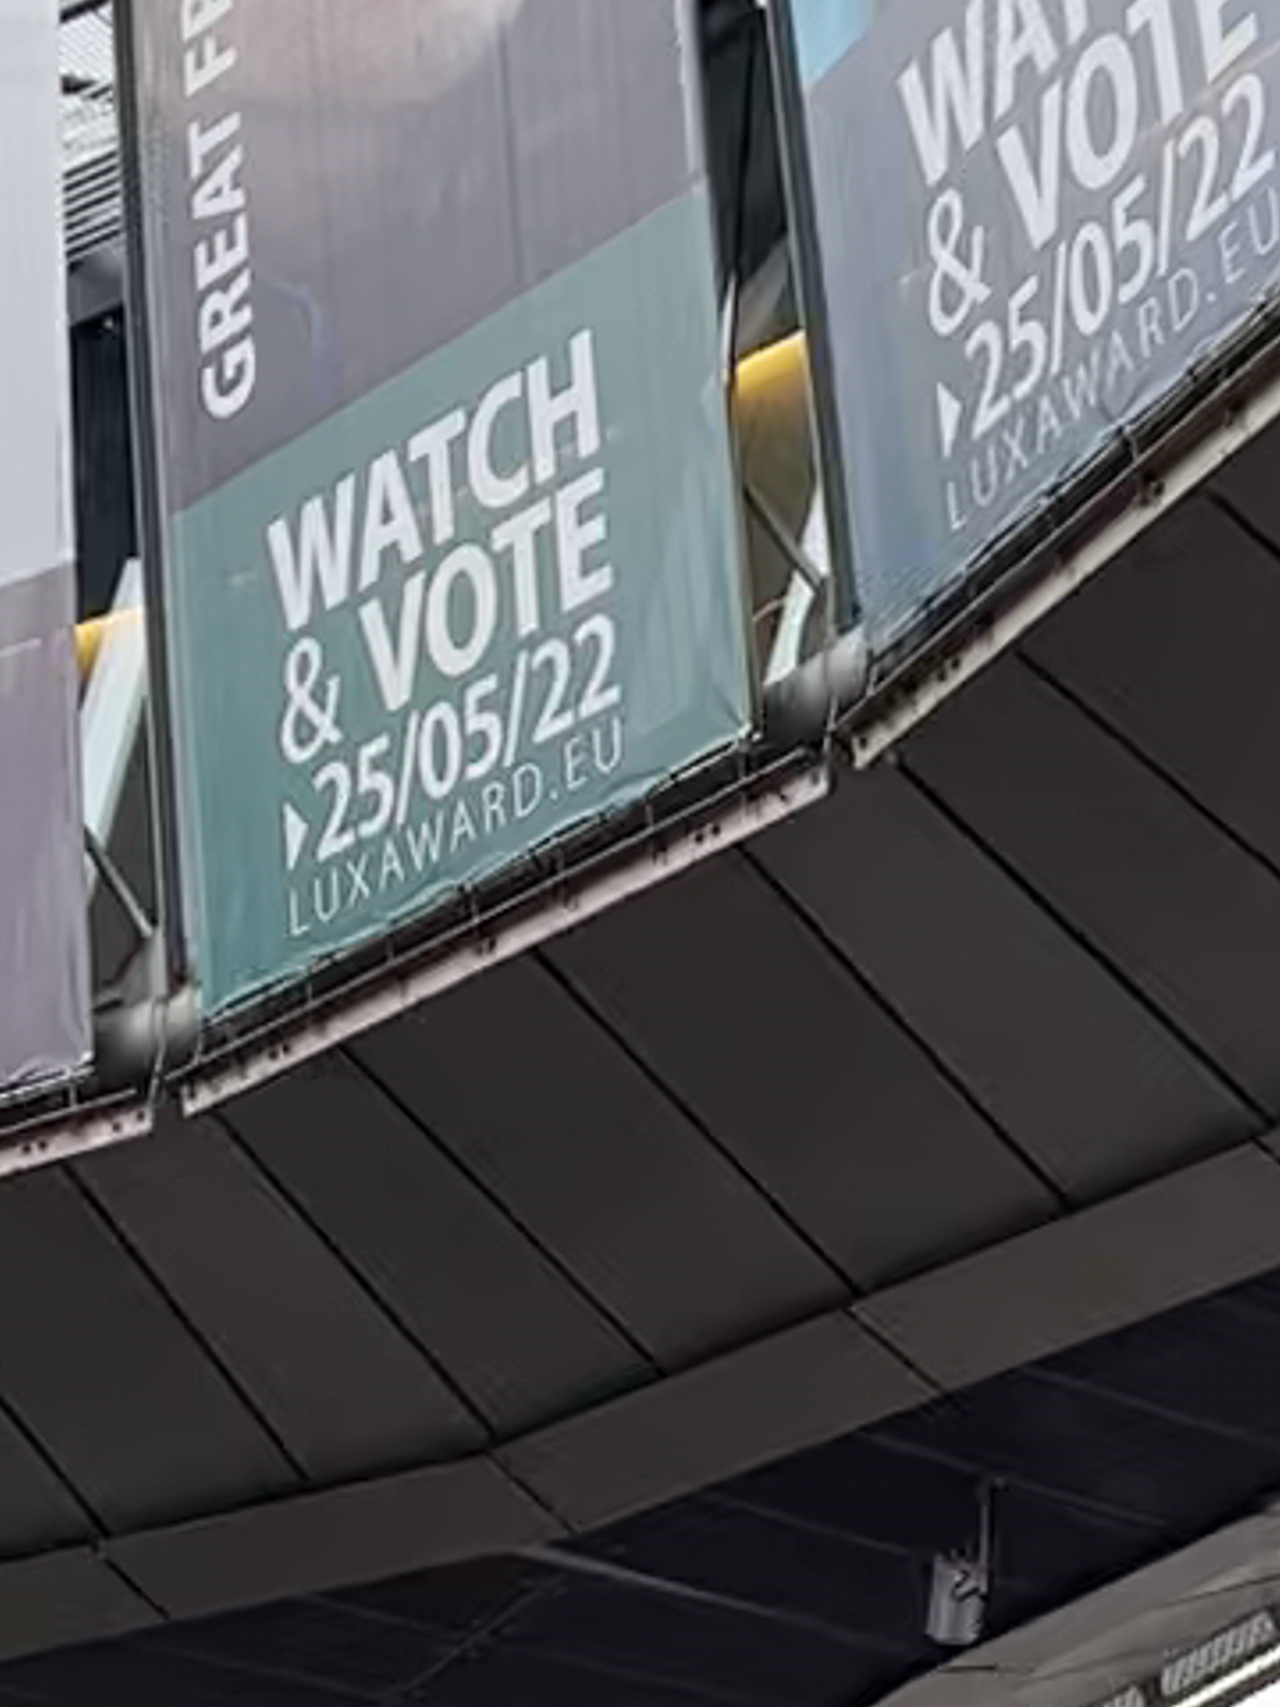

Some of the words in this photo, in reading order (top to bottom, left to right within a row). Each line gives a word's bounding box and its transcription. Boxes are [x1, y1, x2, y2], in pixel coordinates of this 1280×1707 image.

[187, 110, 257, 419] GREAT
[925, 190, 992, 338] &
[965, 72, 1278, 443] 25/05/22
[267, 327, 601, 631] WATCH
[279, 636, 344, 765] &
[358, 467, 613, 712] VOTE
[287, 717, 624, 939] LUXAWARD.EU
[312, 613, 622, 863] 25/05/22
